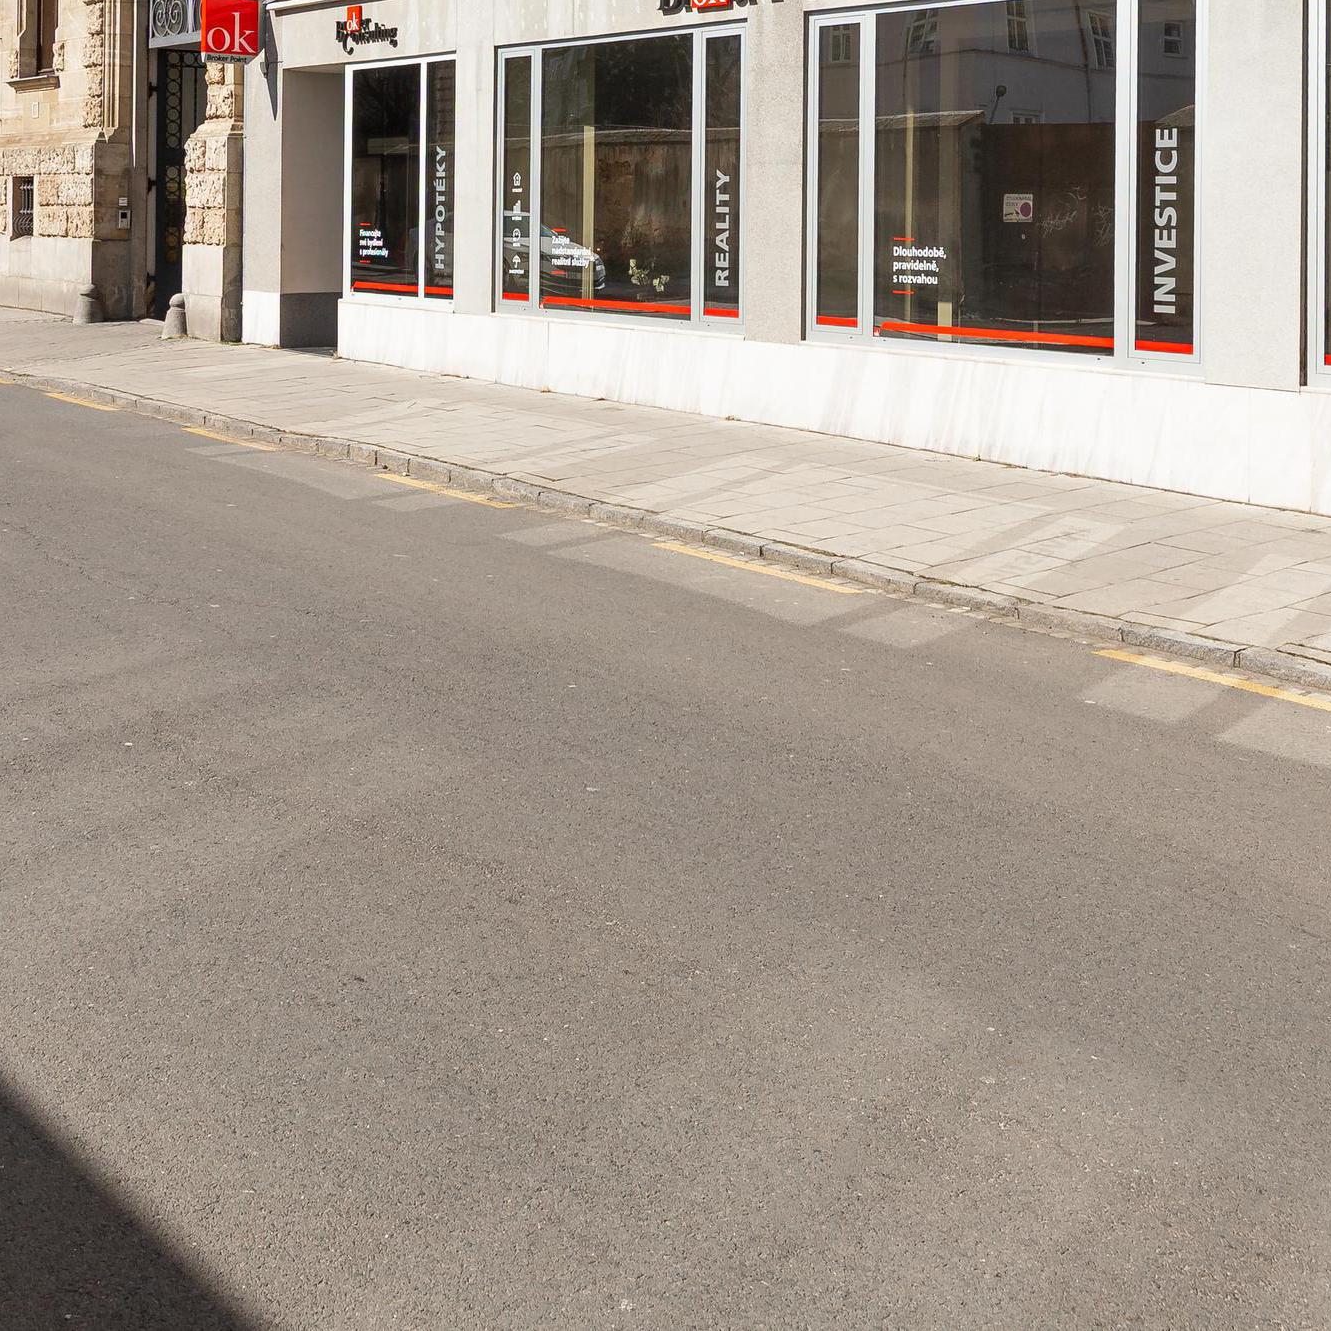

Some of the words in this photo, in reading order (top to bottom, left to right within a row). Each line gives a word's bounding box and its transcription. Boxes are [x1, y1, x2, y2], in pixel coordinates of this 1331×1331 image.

[206, 12, 256, 54] ok
[207, 54, 229, 62] Broker
[230, 55, 247, 63] Point
[434, 145, 447, 270] HYPOTÉKY
[1154, 128, 1178, 314] INVESTICE
[716, 169, 730, 287] REALITY
[893, 246, 947, 259] Dlouhodobě,
[893, 260, 939, 273] pravidelně,
[893, 275, 898, 283] s
[899, 273, 938, 285] rozvahou
